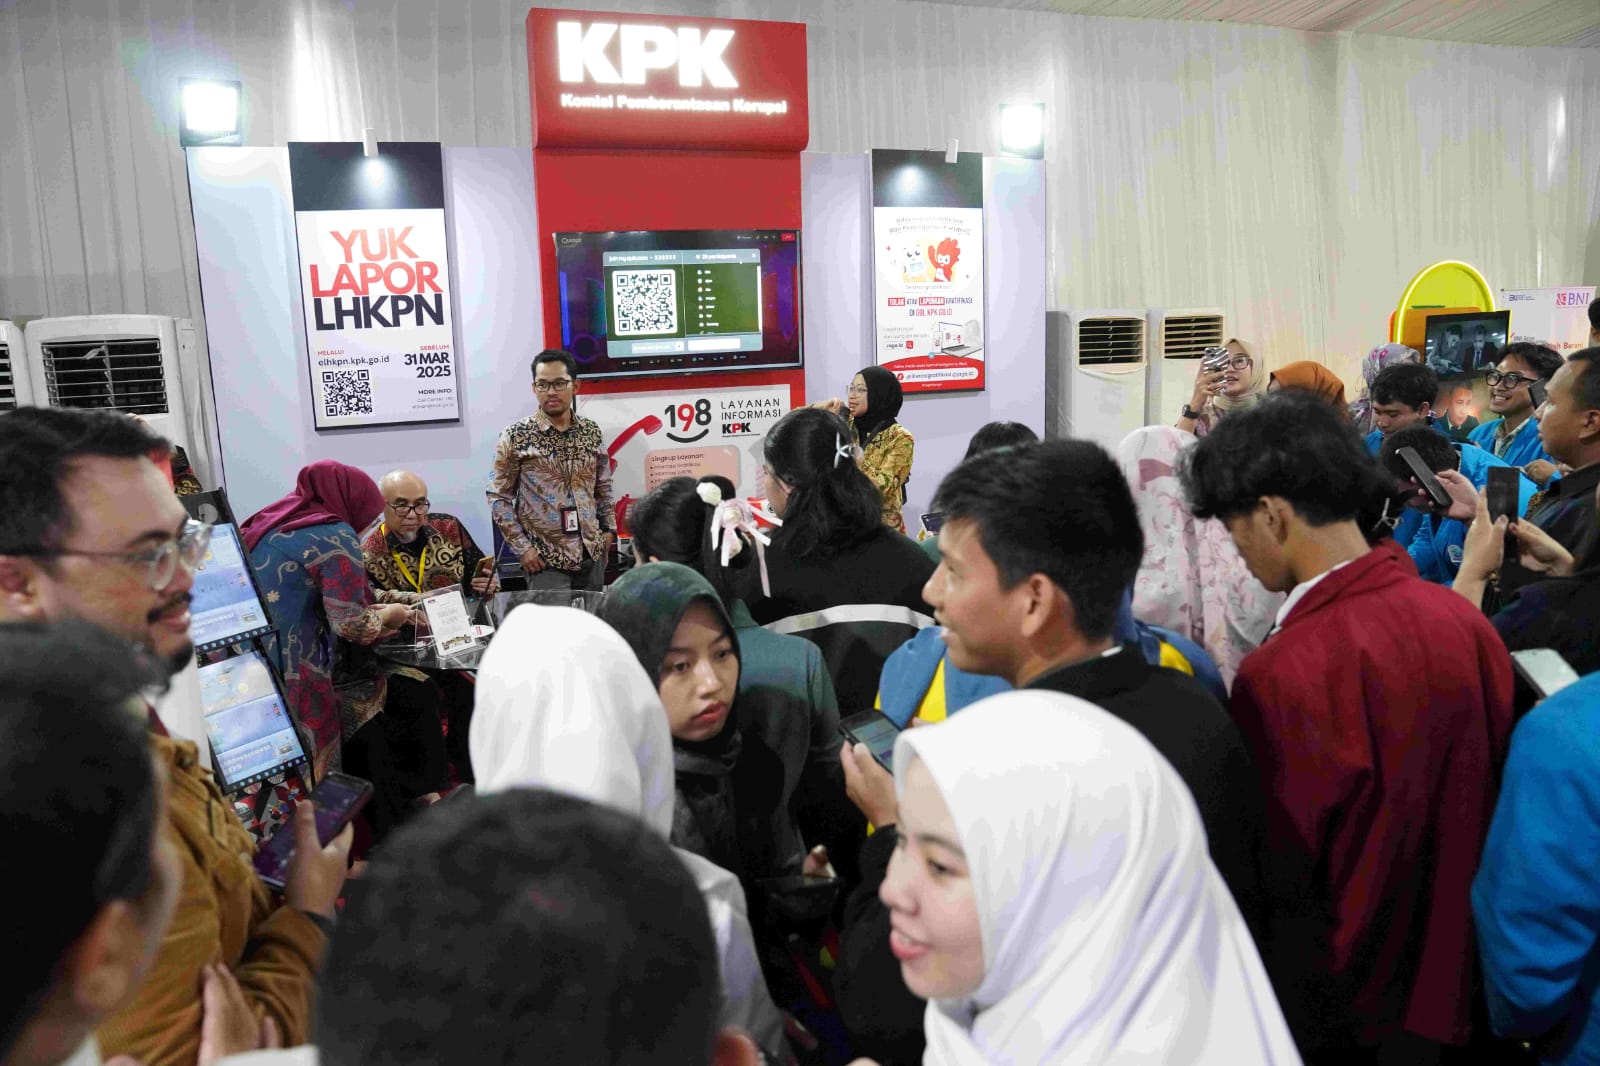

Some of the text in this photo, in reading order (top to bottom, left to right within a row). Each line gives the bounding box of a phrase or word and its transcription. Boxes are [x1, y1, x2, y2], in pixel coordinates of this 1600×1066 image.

[557, 21, 739, 88] KPK
[560, 93, 788, 115] Komisi Pemberantasan Korupsi
[329, 226, 420, 263] YUK
[309, 261, 444, 298] LAPOR
[1568, 292, 1590, 305] BNI
[313, 292, 445, 332] LHKPN
[318, 355, 390, 367] elhkpn.kpk.go.id
[404, 352, 450, 365] 31 MAR
[416, 365, 451, 378] 2025
[720, 397, 780, 410] LAYANAN
[664, 398, 712, 432] 198
[721, 408, 781, 421] INFORMASI
[722, 422, 752, 434] KPK
